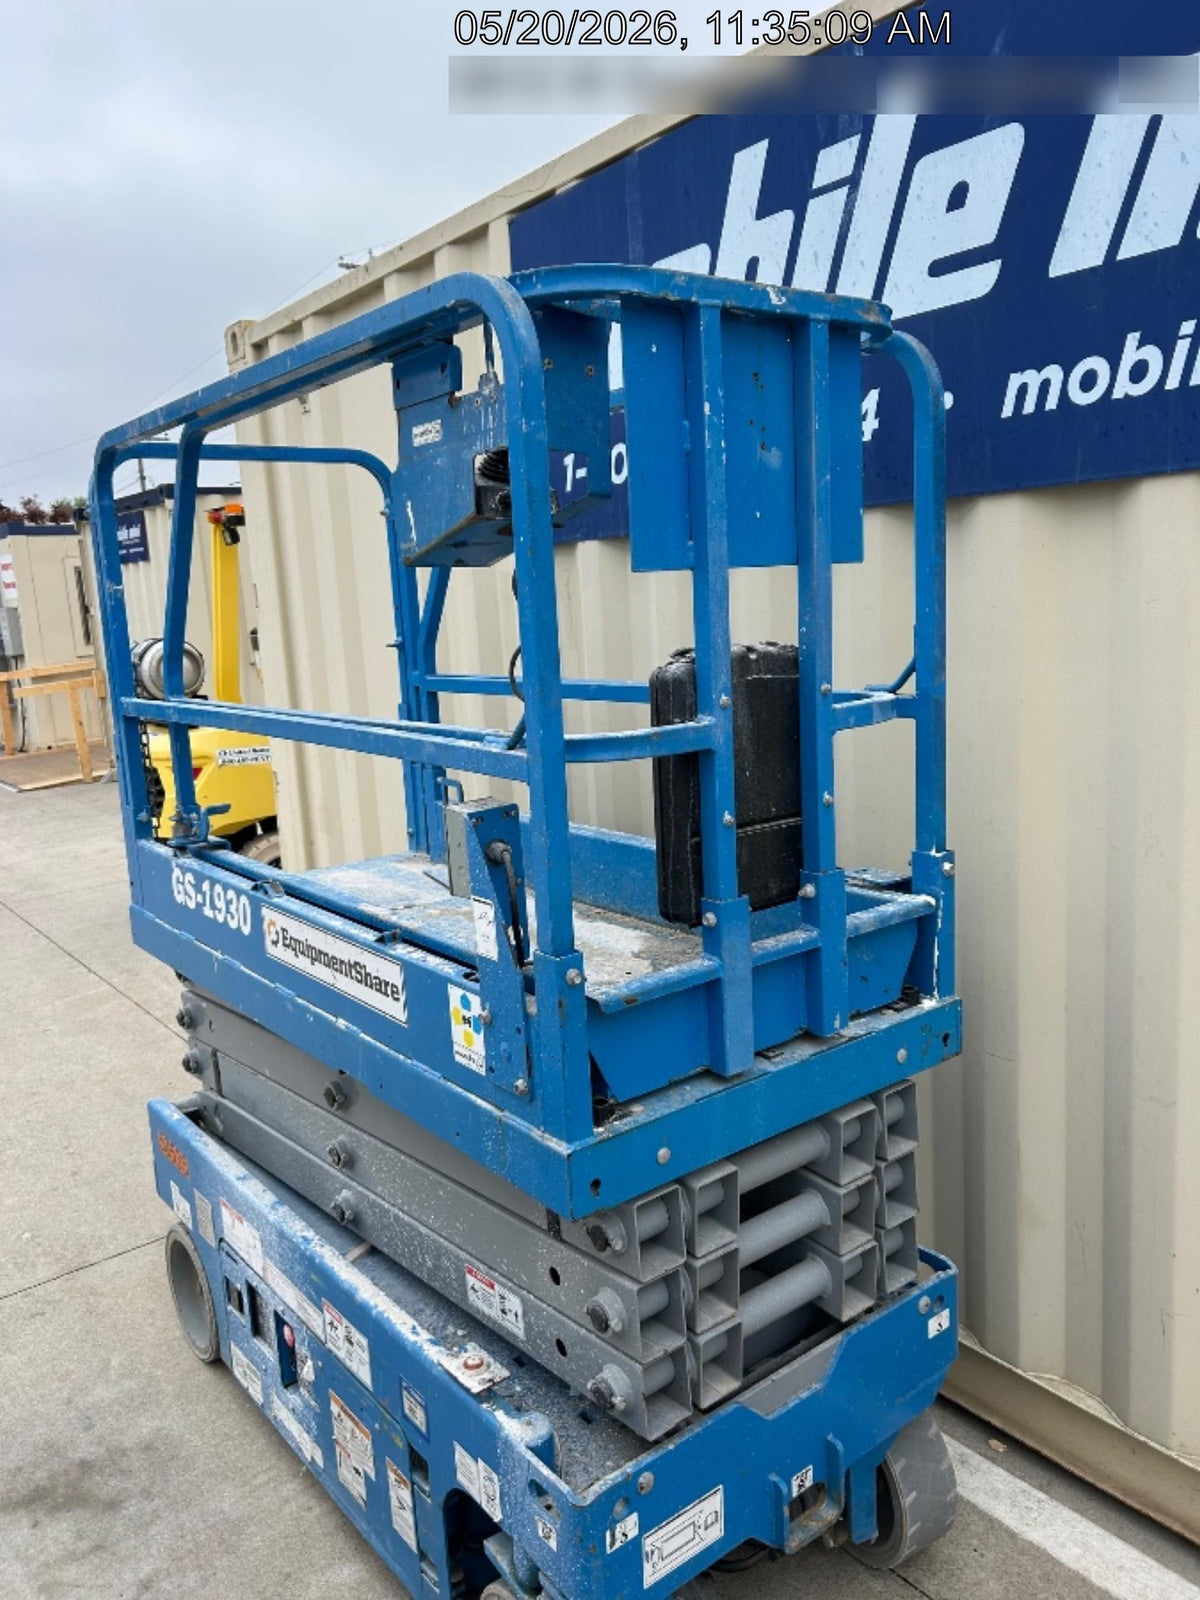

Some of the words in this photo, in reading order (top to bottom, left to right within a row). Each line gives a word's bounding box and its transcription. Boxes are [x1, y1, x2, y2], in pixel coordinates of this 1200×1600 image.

[645, 114, 1025, 322] bile
[1001, 319, 1200, 419] mobi
[171, 867, 252, 936] GS-1930
[280, 926, 401, 1002] EquipmentShare
